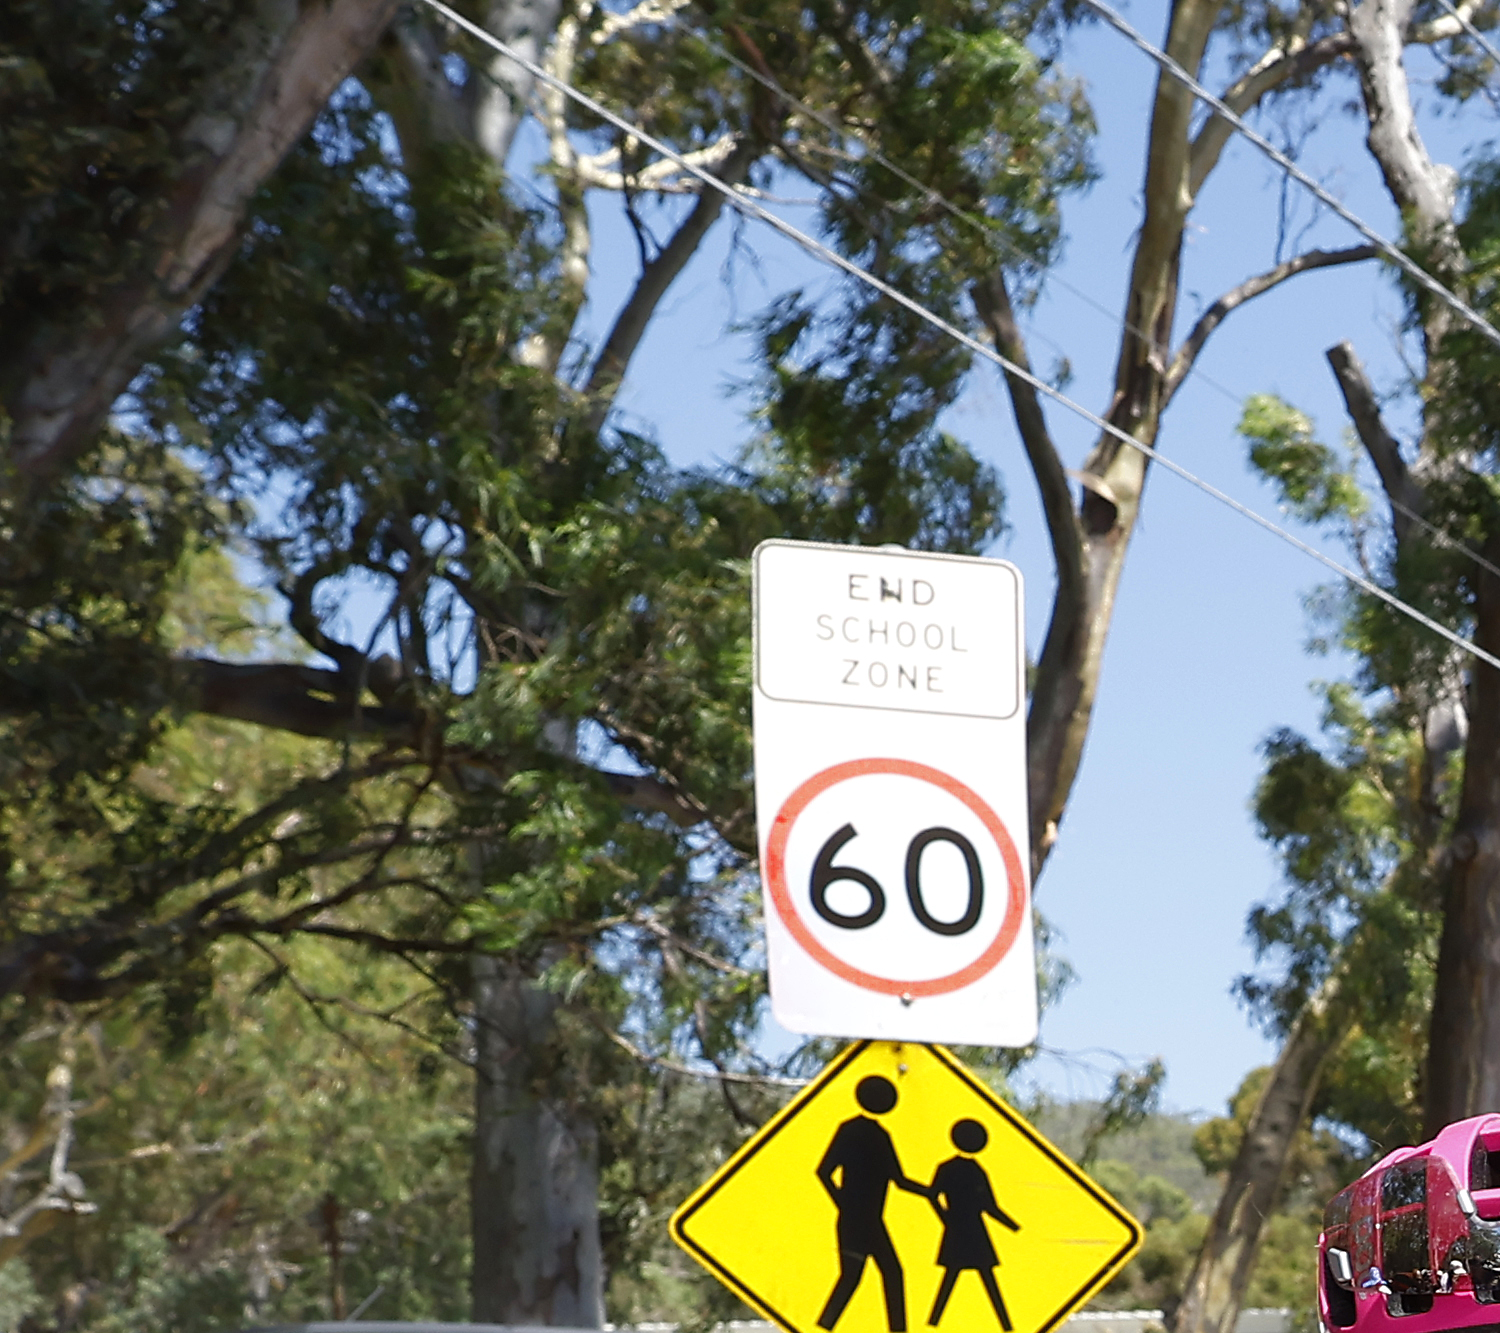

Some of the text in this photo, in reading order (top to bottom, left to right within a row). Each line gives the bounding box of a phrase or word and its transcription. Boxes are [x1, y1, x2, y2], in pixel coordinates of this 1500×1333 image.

[847, 572, 936, 607] END
[815, 613, 969, 653] SCHOOL
[841, 658, 944, 694] ZONE
[808, 821, 985, 937] 60
